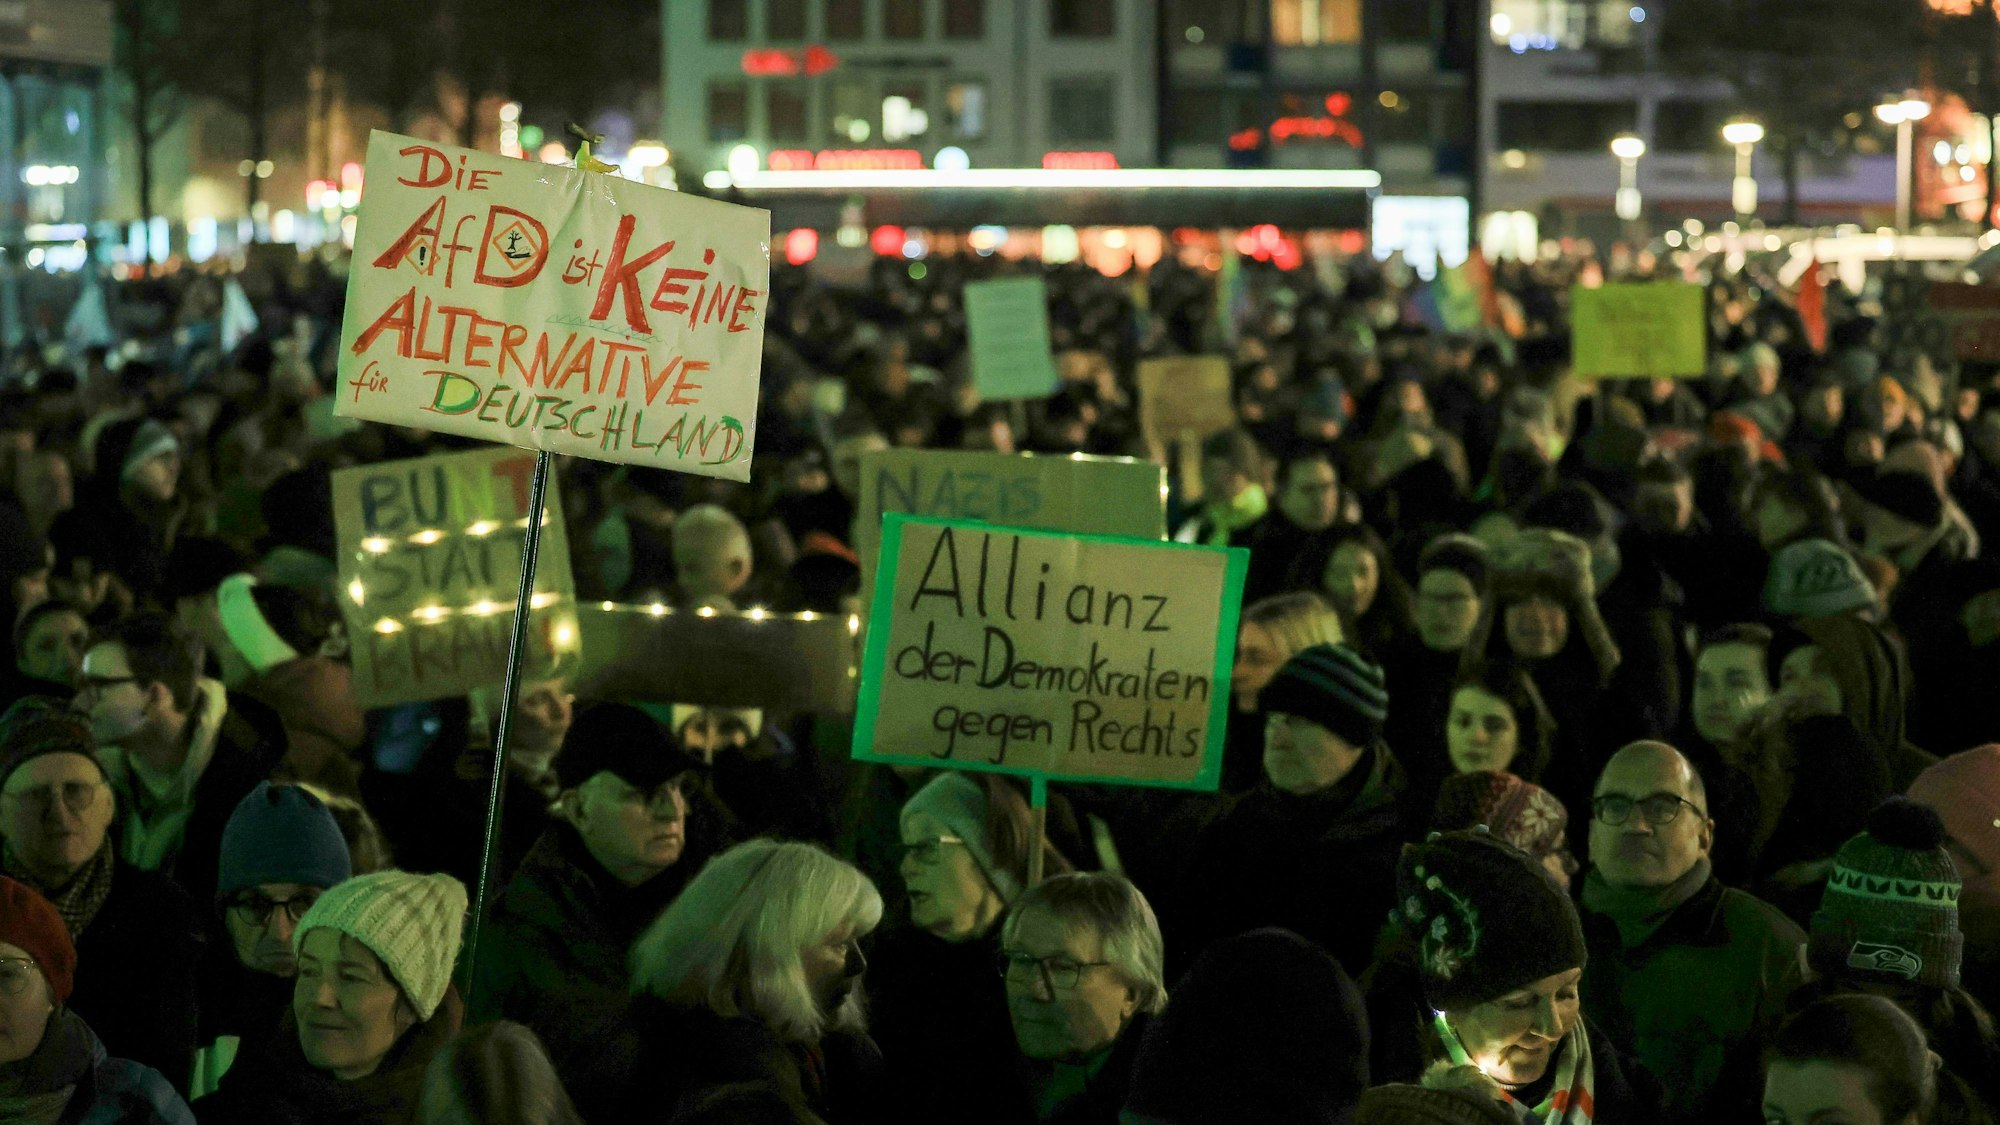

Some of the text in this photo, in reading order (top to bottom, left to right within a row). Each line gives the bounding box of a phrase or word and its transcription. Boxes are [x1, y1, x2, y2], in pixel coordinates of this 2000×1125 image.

[373, 195, 550, 288] AfD
[561, 238, 603, 286] ist
[421, 370, 745, 465] DEUTSCHLAND
[360, 455, 537, 531] BUNT
[877, 465, 1043, 523] NAZIS
[910, 526, 1171, 632] Allianz
[895, 621, 1208, 703] der Demokraten
[931, 700, 1201, 764] gegen Rechts
